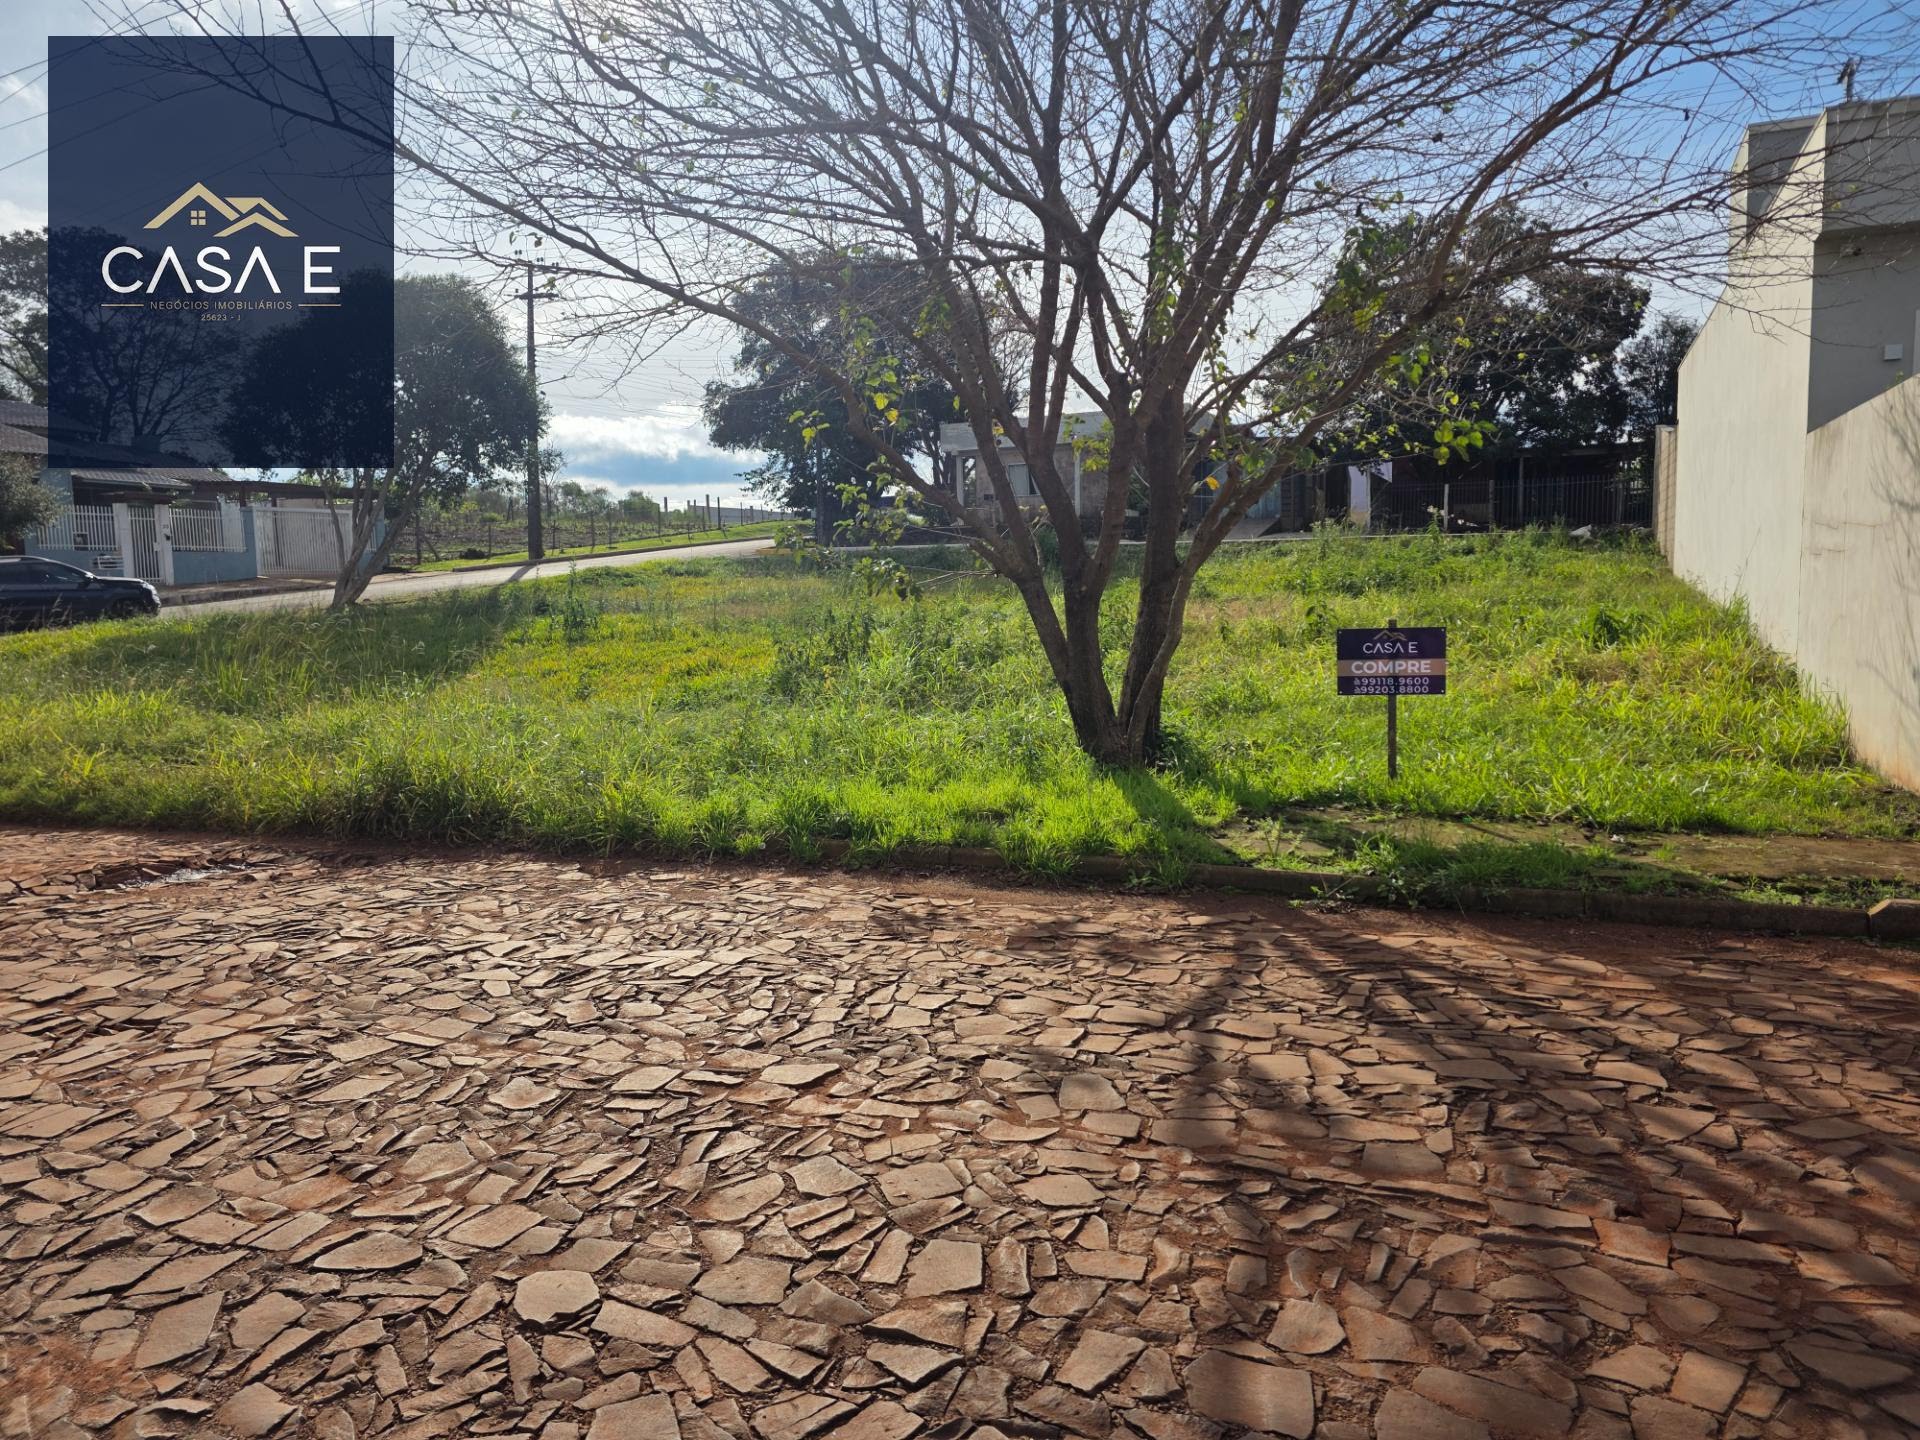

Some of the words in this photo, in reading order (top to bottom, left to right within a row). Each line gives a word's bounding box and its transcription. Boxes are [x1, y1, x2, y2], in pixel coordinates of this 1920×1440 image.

[1362, 642, 1404, 654] CASA
[1408, 641, 1418, 653] E
[1351, 660, 1431, 674] COMPRE
